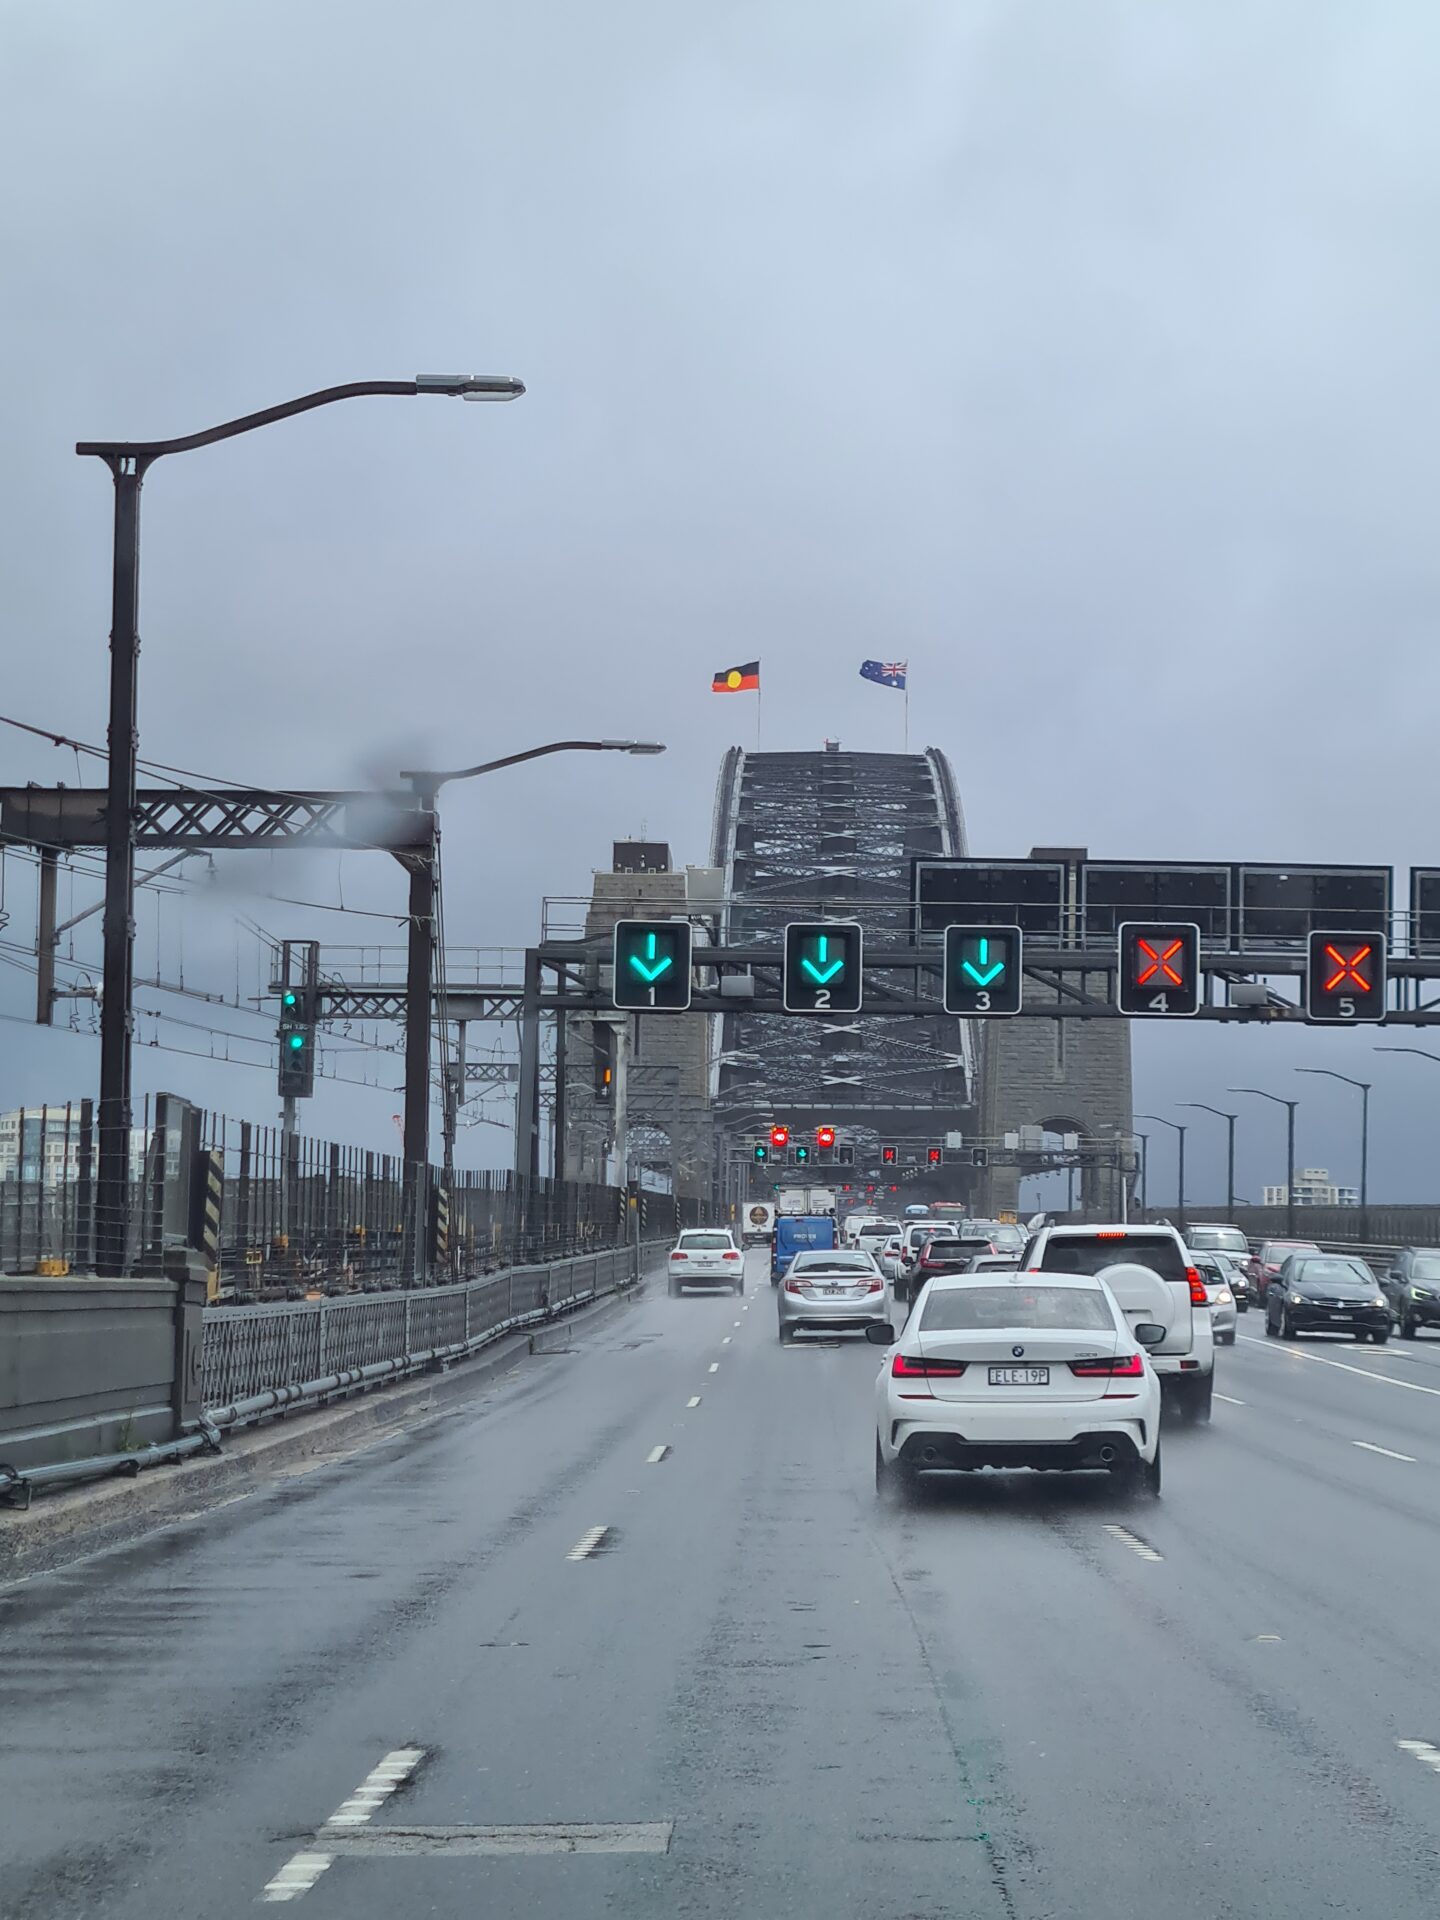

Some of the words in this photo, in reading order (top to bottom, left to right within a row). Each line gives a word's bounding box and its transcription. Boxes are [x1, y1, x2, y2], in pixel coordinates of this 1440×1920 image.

[648, 987, 656, 1006] 1
[815, 989, 831, 1009] 2
[975, 990, 991, 1010] 3
[1149, 992, 1169, 1012] 4
[1340, 998, 1355, 1017] 5
[995, 1370, 1046, 1382] ELE-19P
